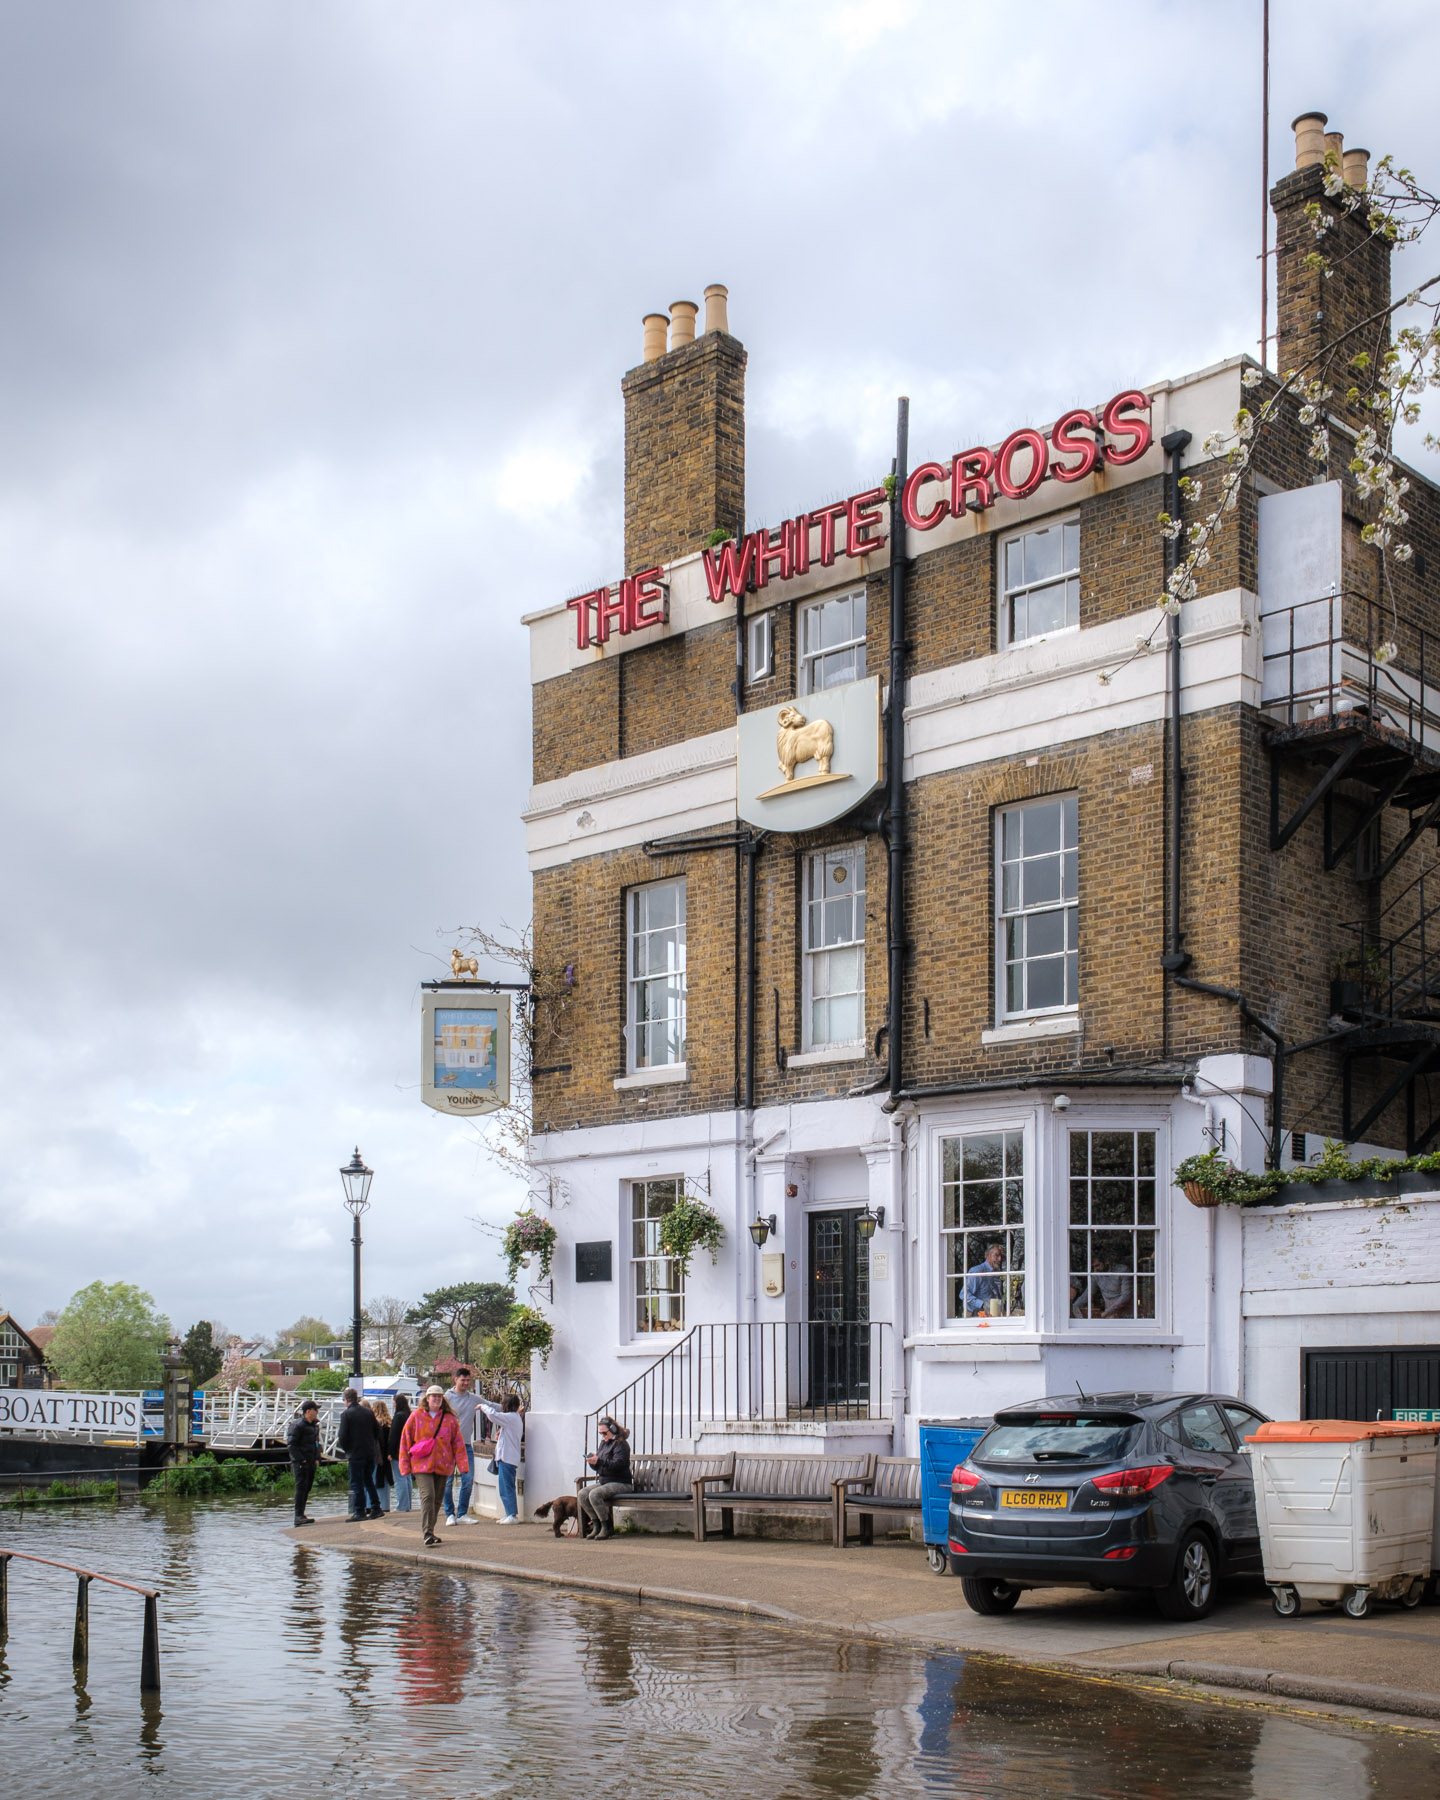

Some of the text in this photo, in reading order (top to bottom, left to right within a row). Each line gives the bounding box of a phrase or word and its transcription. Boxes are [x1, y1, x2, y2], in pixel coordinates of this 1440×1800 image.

[566, 390, 1152, 649] THE WHITE CROSS
[0, 1396, 63, 1424] BOAT
[67, 1399, 136, 1426] TRIPS
[1396, 1412, 1427, 1422] FIRE
[1006, 1492, 1063, 1505] LC60 RHX
